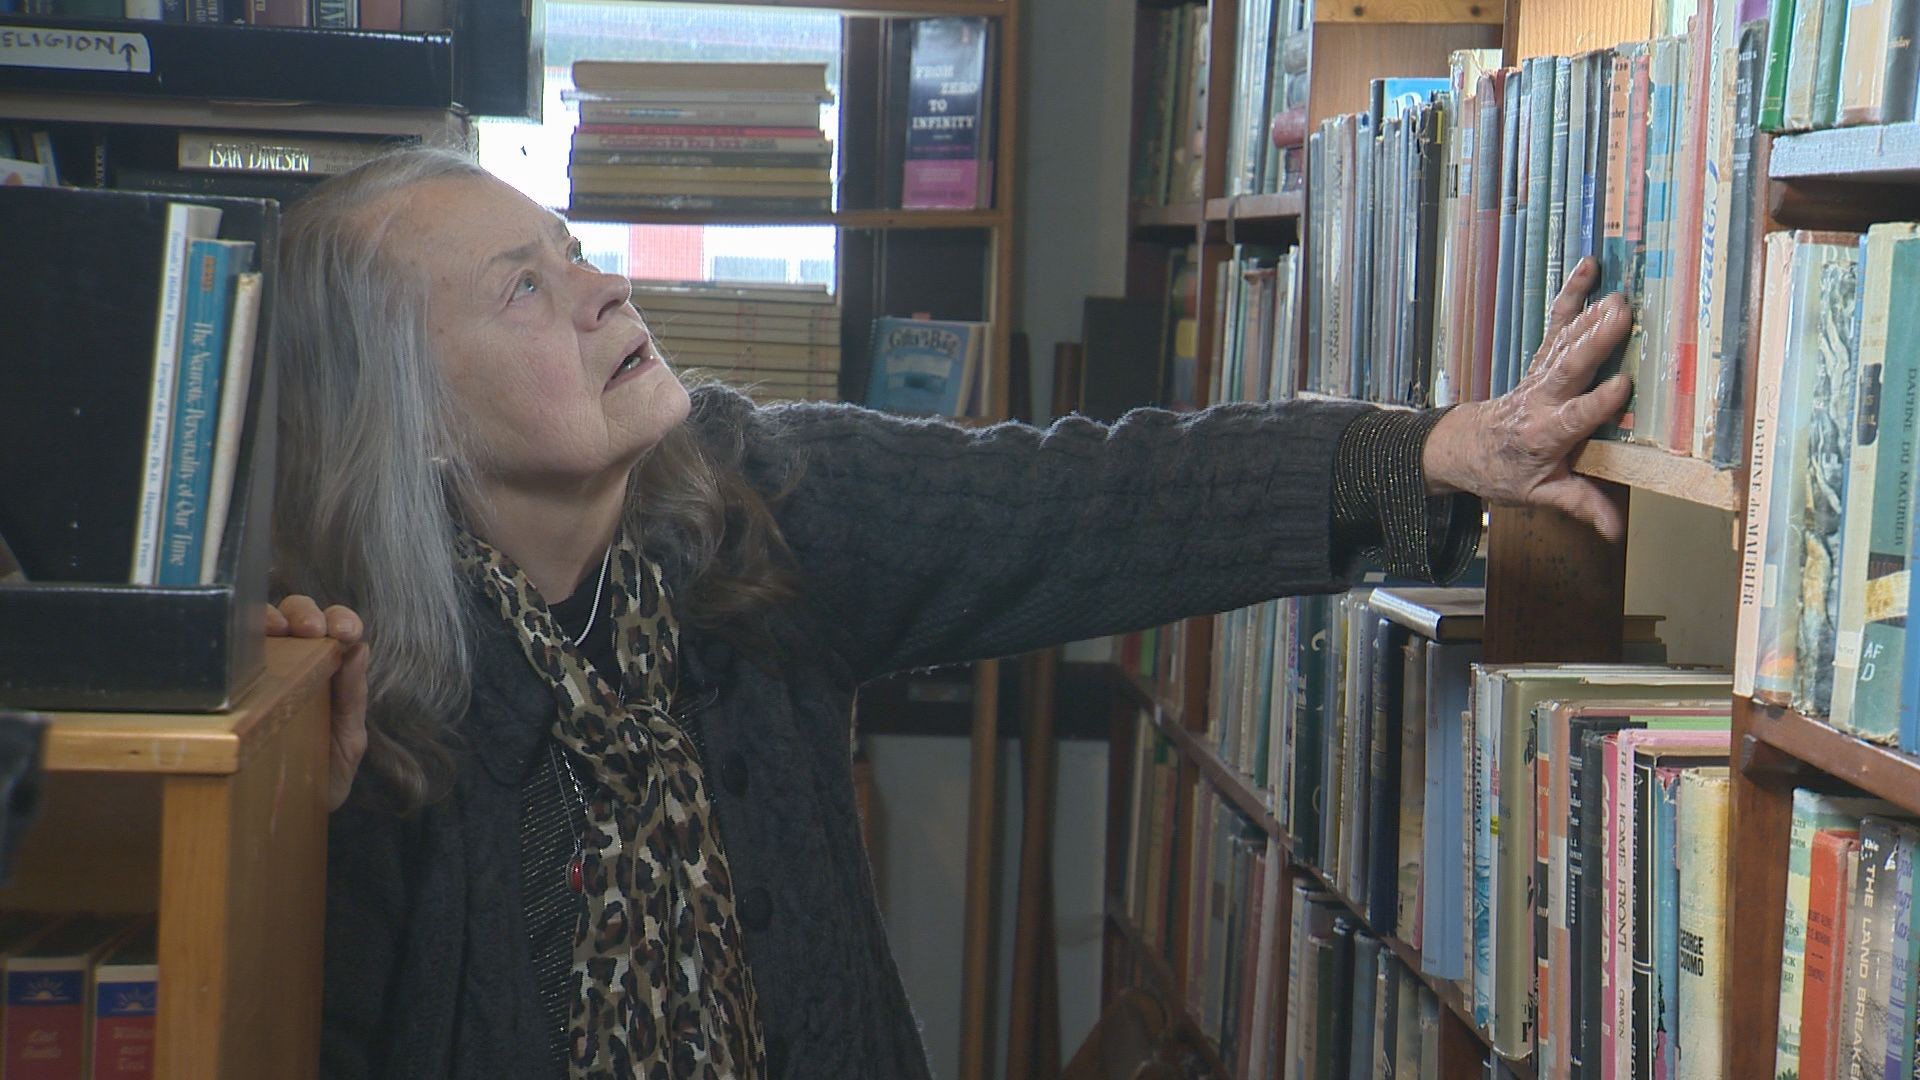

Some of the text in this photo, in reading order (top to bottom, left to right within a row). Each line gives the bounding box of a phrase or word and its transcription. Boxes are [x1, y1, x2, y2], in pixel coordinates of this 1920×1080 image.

[1, 31, 115, 55] ELIGION
[914, 64, 954, 80] FROM
[941, 81, 978, 96] ZERO
[928, 99, 948, 114] TO
[912, 115, 975, 130] INFINITY
[246, 144, 310, 173] DINESEN
[191, 320, 215, 346] The
[184, 350, 212, 404] Neurotic
[174, 407, 206, 481] Personality
[1751, 418, 1765, 492] DAPHNE
[1894, 367, 1918, 546] DAPHNE DU MAURIER
[176, 483, 196, 498] of
[173, 499, 196, 529] Our
[168, 533, 193, 567] Time
[1743, 524, 1760, 606] MAURIER
[1863, 641, 1884, 660] AF
[1860, 662, 1876, 682] D
[1618, 802, 1627, 867] HOME
[1863, 863, 1876, 908] THE
[1617, 878, 1627, 952] FRONT
[1859, 917, 1872, 979] LAND
